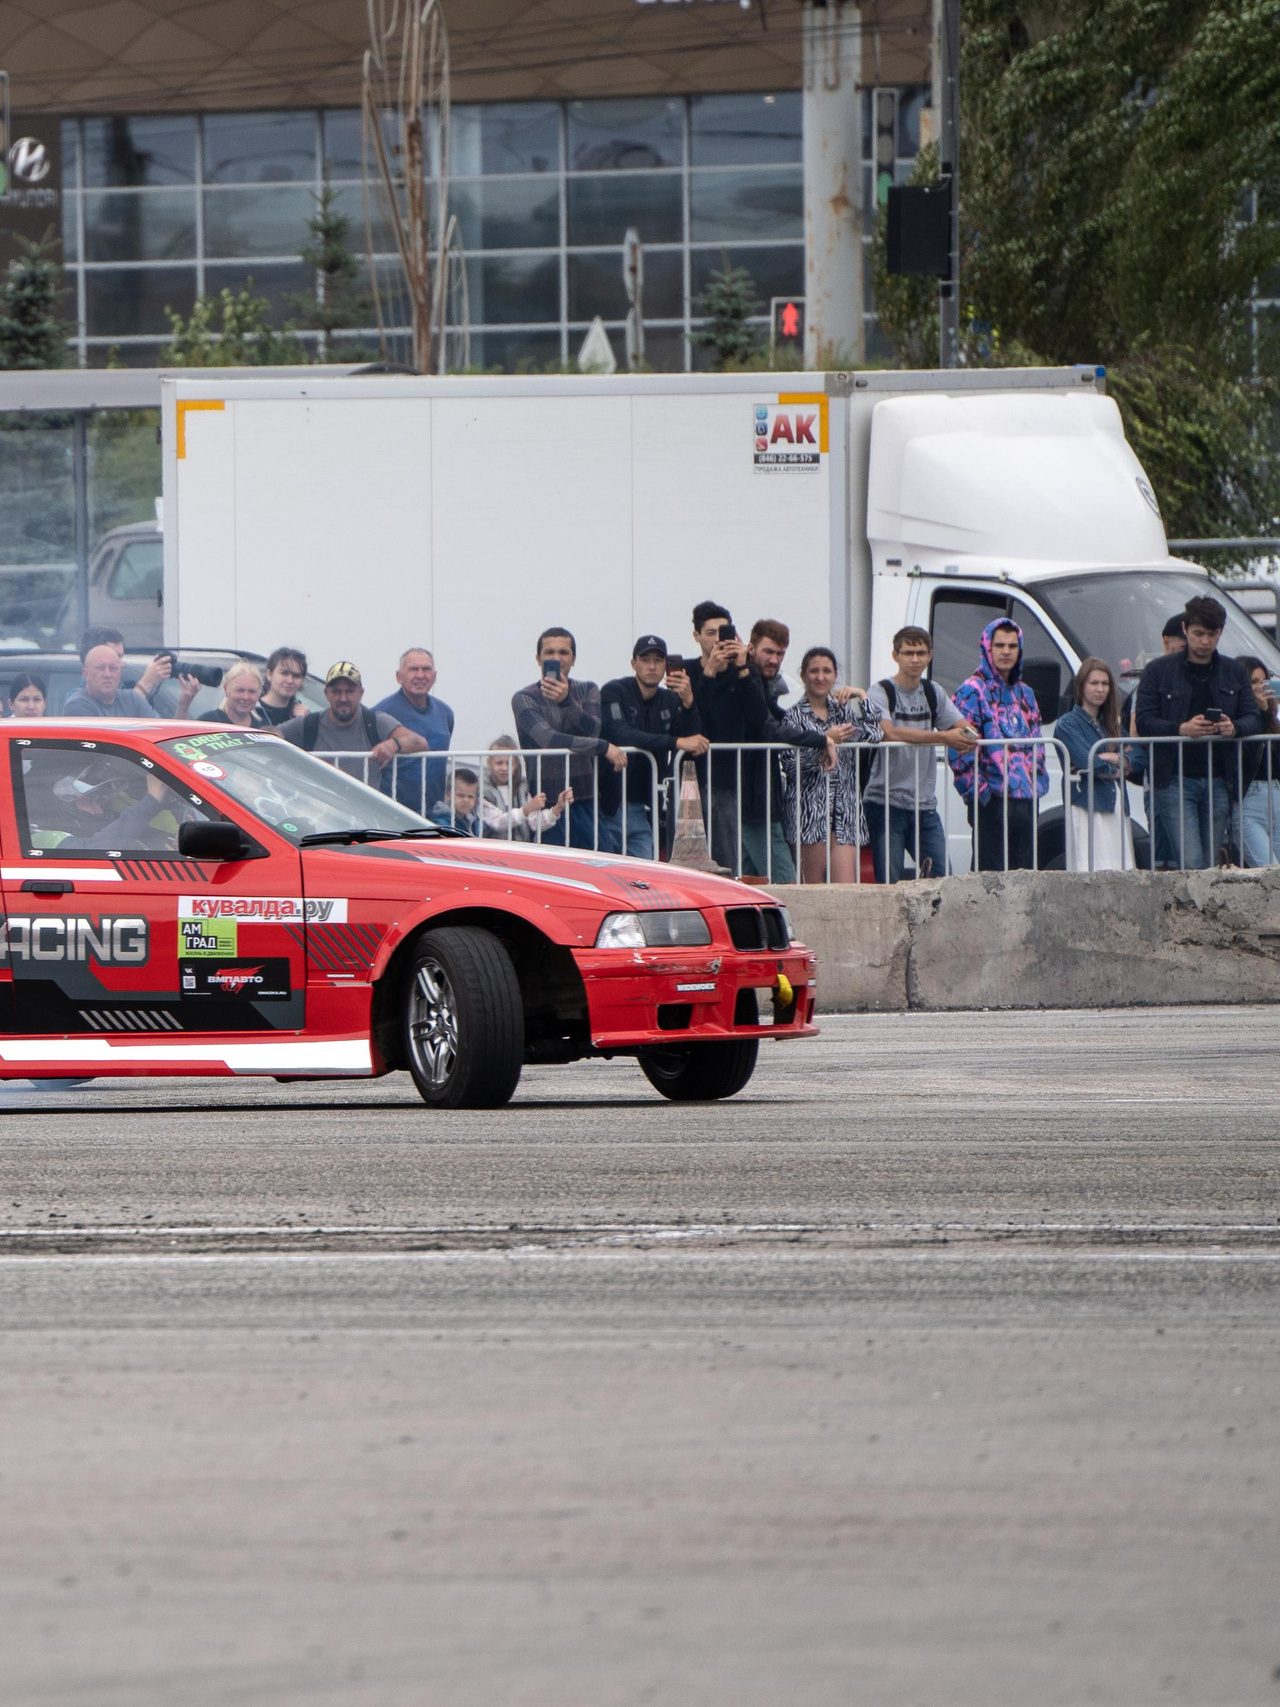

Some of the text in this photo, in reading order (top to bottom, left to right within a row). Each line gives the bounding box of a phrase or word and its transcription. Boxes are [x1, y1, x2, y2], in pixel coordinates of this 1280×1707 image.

[755, 466, 781, 474] ПРОДАЖА
[188, 732, 232, 747] DRIFT
[192, 898, 333, 921] кувалда.ру
[183, 923, 202, 935] АМ
[186, 937, 217, 949] ГРАД
[207, 975, 264, 984] ВМПАВТО
